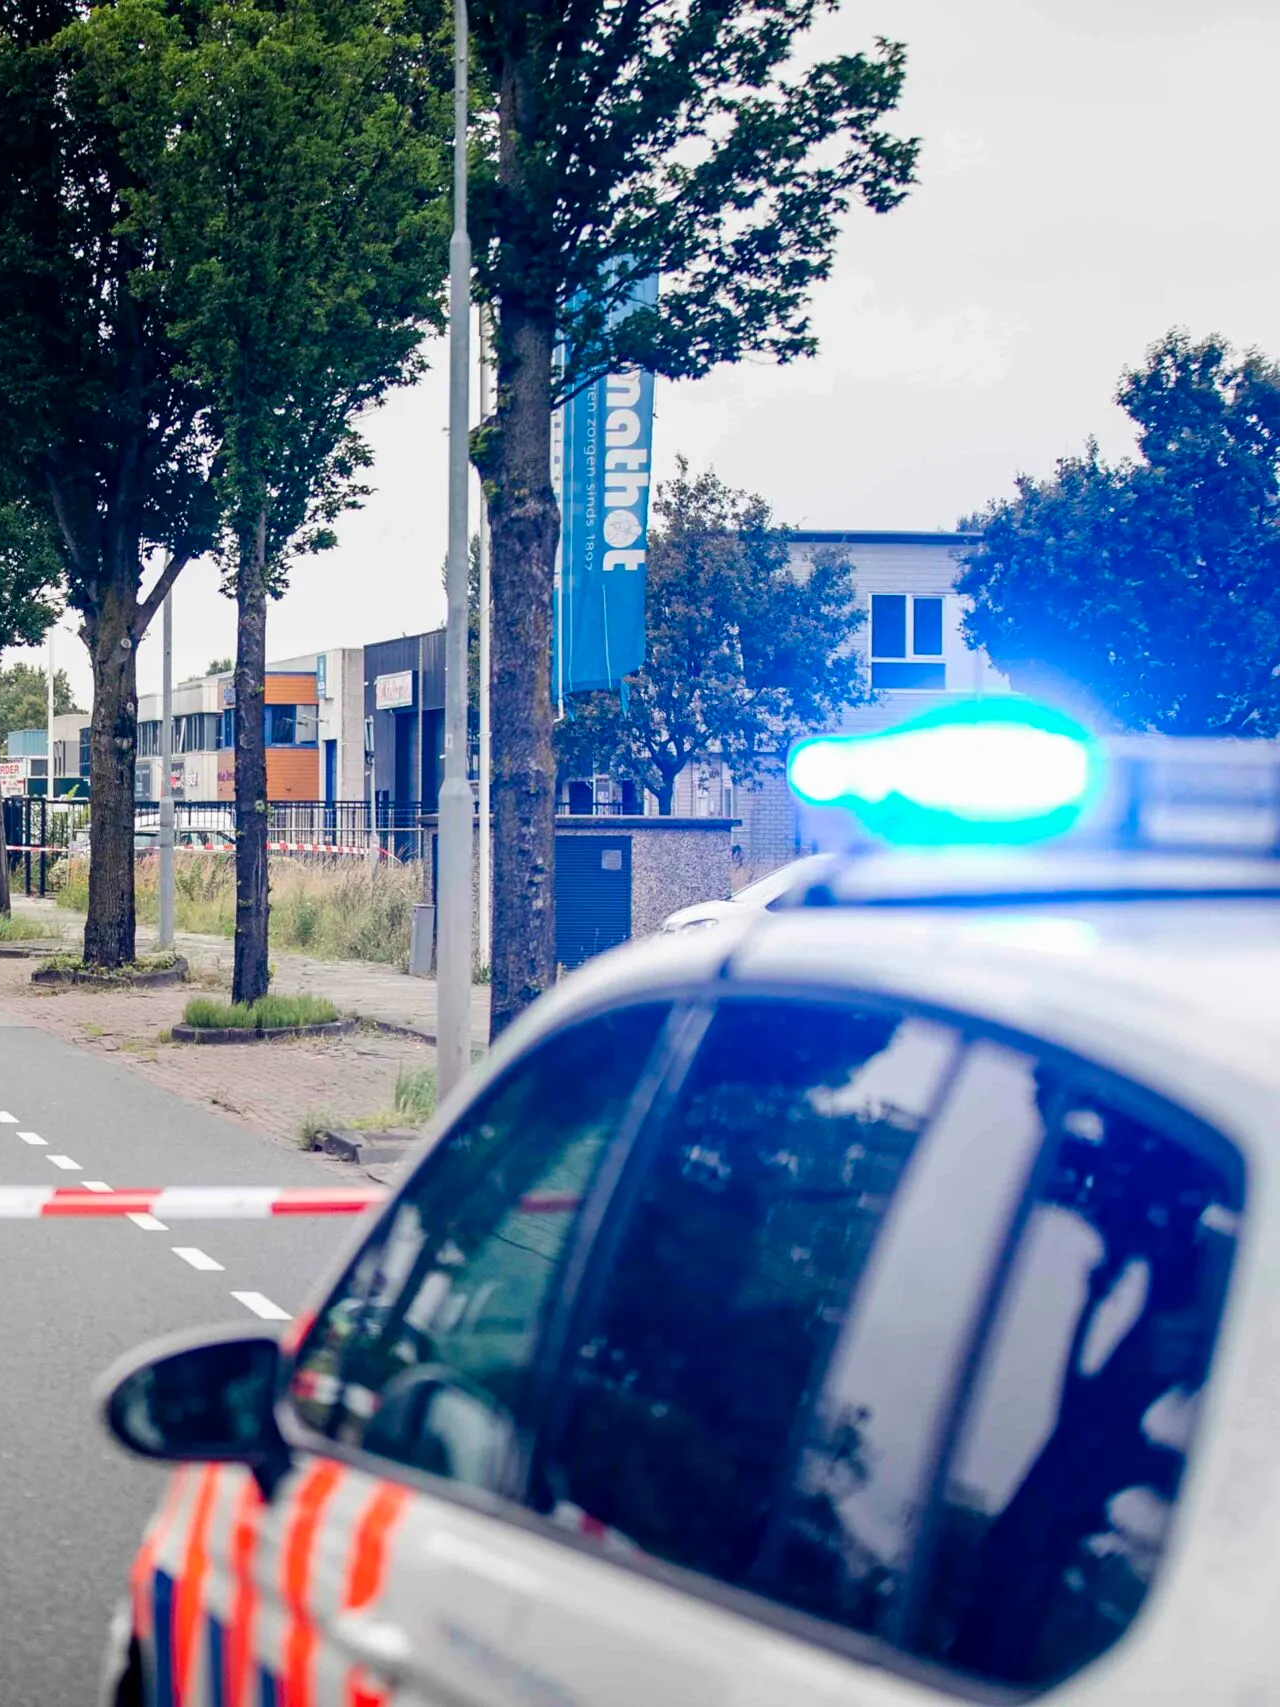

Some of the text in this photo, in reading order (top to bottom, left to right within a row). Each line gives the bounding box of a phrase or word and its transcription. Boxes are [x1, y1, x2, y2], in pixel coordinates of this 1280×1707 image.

[583, 418, 597, 477] zorgen
[585, 483, 597, 527] sinds
[584, 534, 596, 571] 1897
